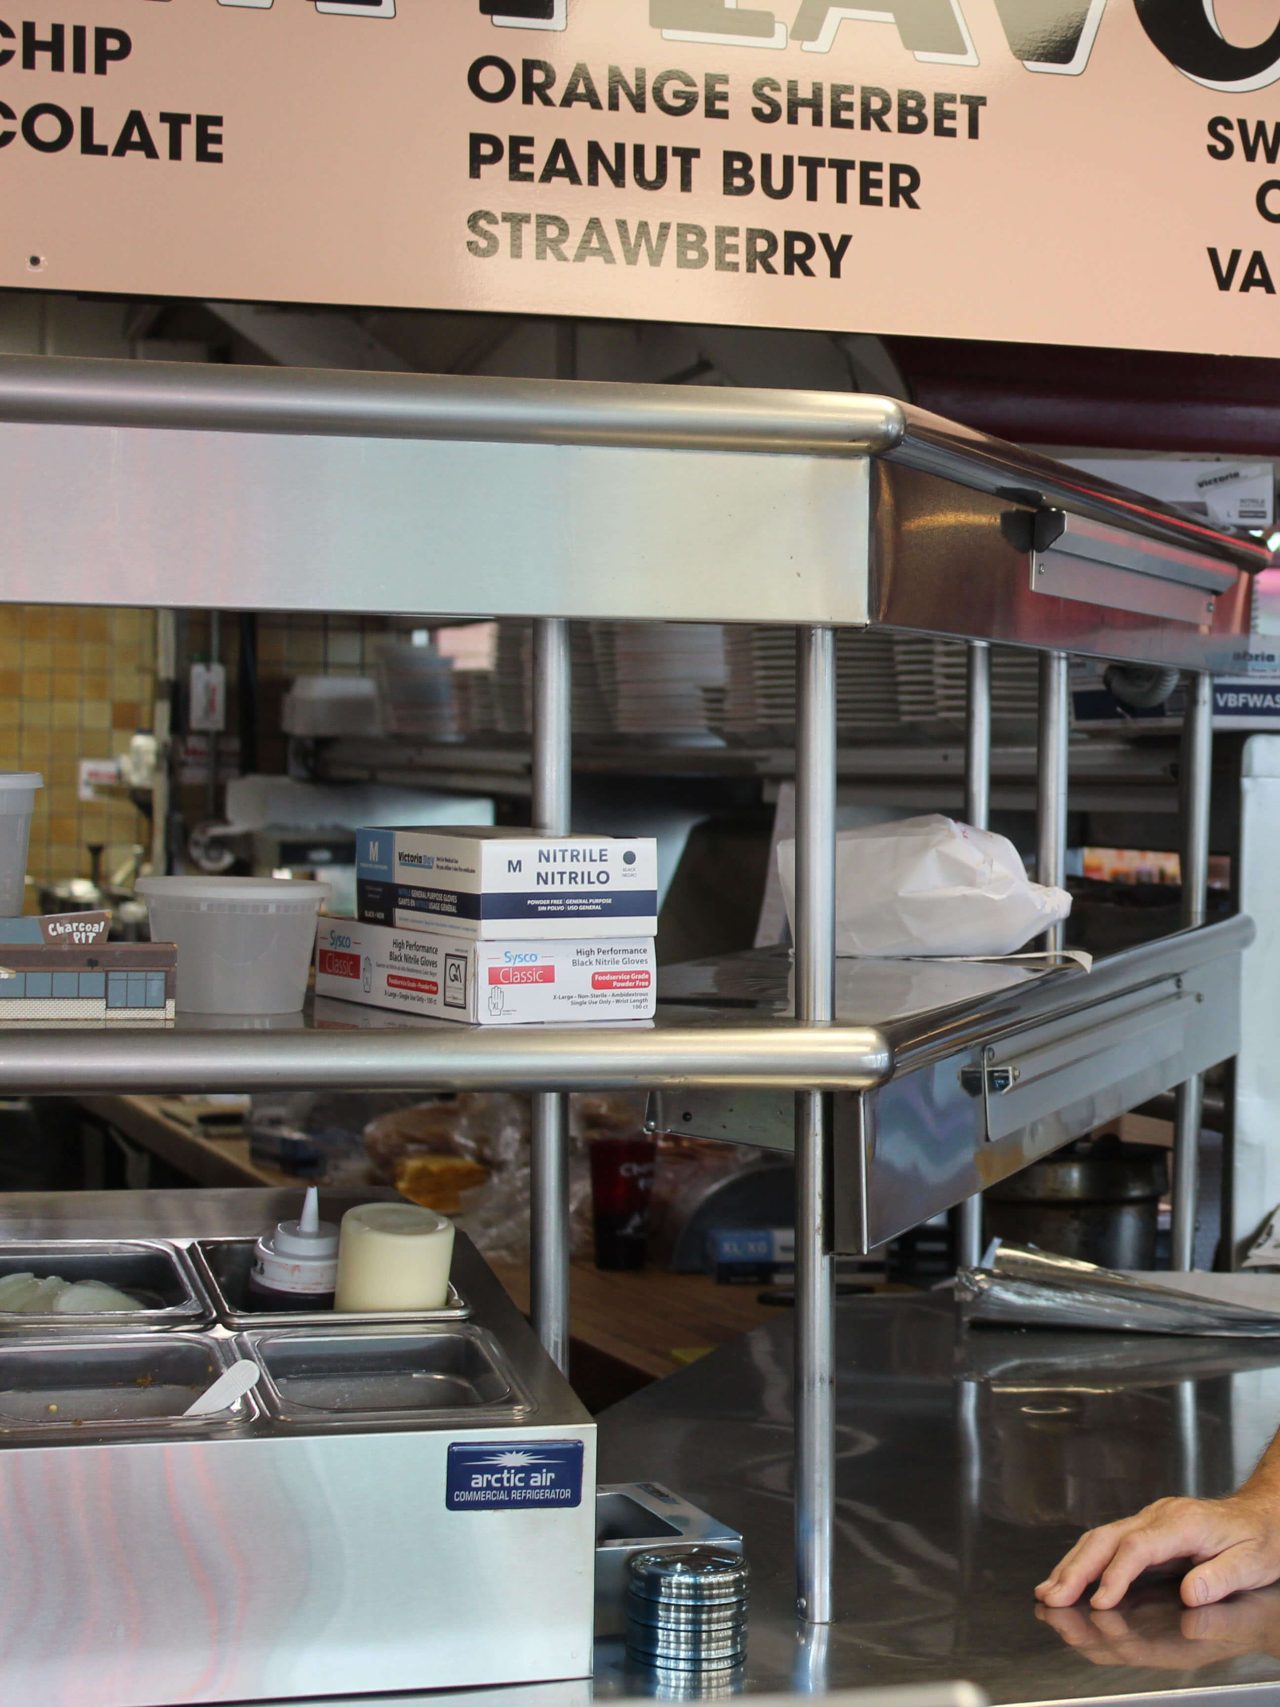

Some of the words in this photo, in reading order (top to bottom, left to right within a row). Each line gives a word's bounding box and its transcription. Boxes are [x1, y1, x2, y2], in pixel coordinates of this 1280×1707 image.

[467, 55, 729, 120] ORANGE
[751, 77, 987, 140] SHERBET
[469, 132, 701, 193] PEANUT
[723, 150, 921, 209] BUTTER
[466, 210, 853, 279] STRAWBERRY
[369, 841, 378, 862] M
[538, 848, 609, 863] NITRILE
[508, 859, 522, 873] M
[536, 870, 610, 885] NITRILO
[48, 921, 105, 936] Charcoal
[73, 931, 97, 944] PIT
[329, 930, 351, 948] Sysco
[392, 938, 405, 951] High
[405, 940, 439, 955] Performance
[576, 948, 595, 957] High
[597, 947, 648, 956] Performance
[326, 953, 354, 976] Classic
[389, 950, 403, 962] Black
[403, 953, 419, 965] Nitrile
[420, 956, 438, 968] Gloves
[504, 951, 538, 964] Sysco
[572, 959, 593, 967] Black
[595, 958, 620, 966] Nitrile
[621, 957, 648, 965] Gloves
[500, 968, 544, 983] Classic
[594, 973, 631, 981] Foodservice
[631, 972, 649, 980] Grade
[599, 998, 611, 1006] Only
[629, 997, 649, 1005] Length
[471, 1469, 525, 1488] arctic
[530, 1468, 555, 1486] air
[453, 1490, 509, 1502] COMMERCIAL
[511, 1488, 572, 1500] REFRIGERATOR
